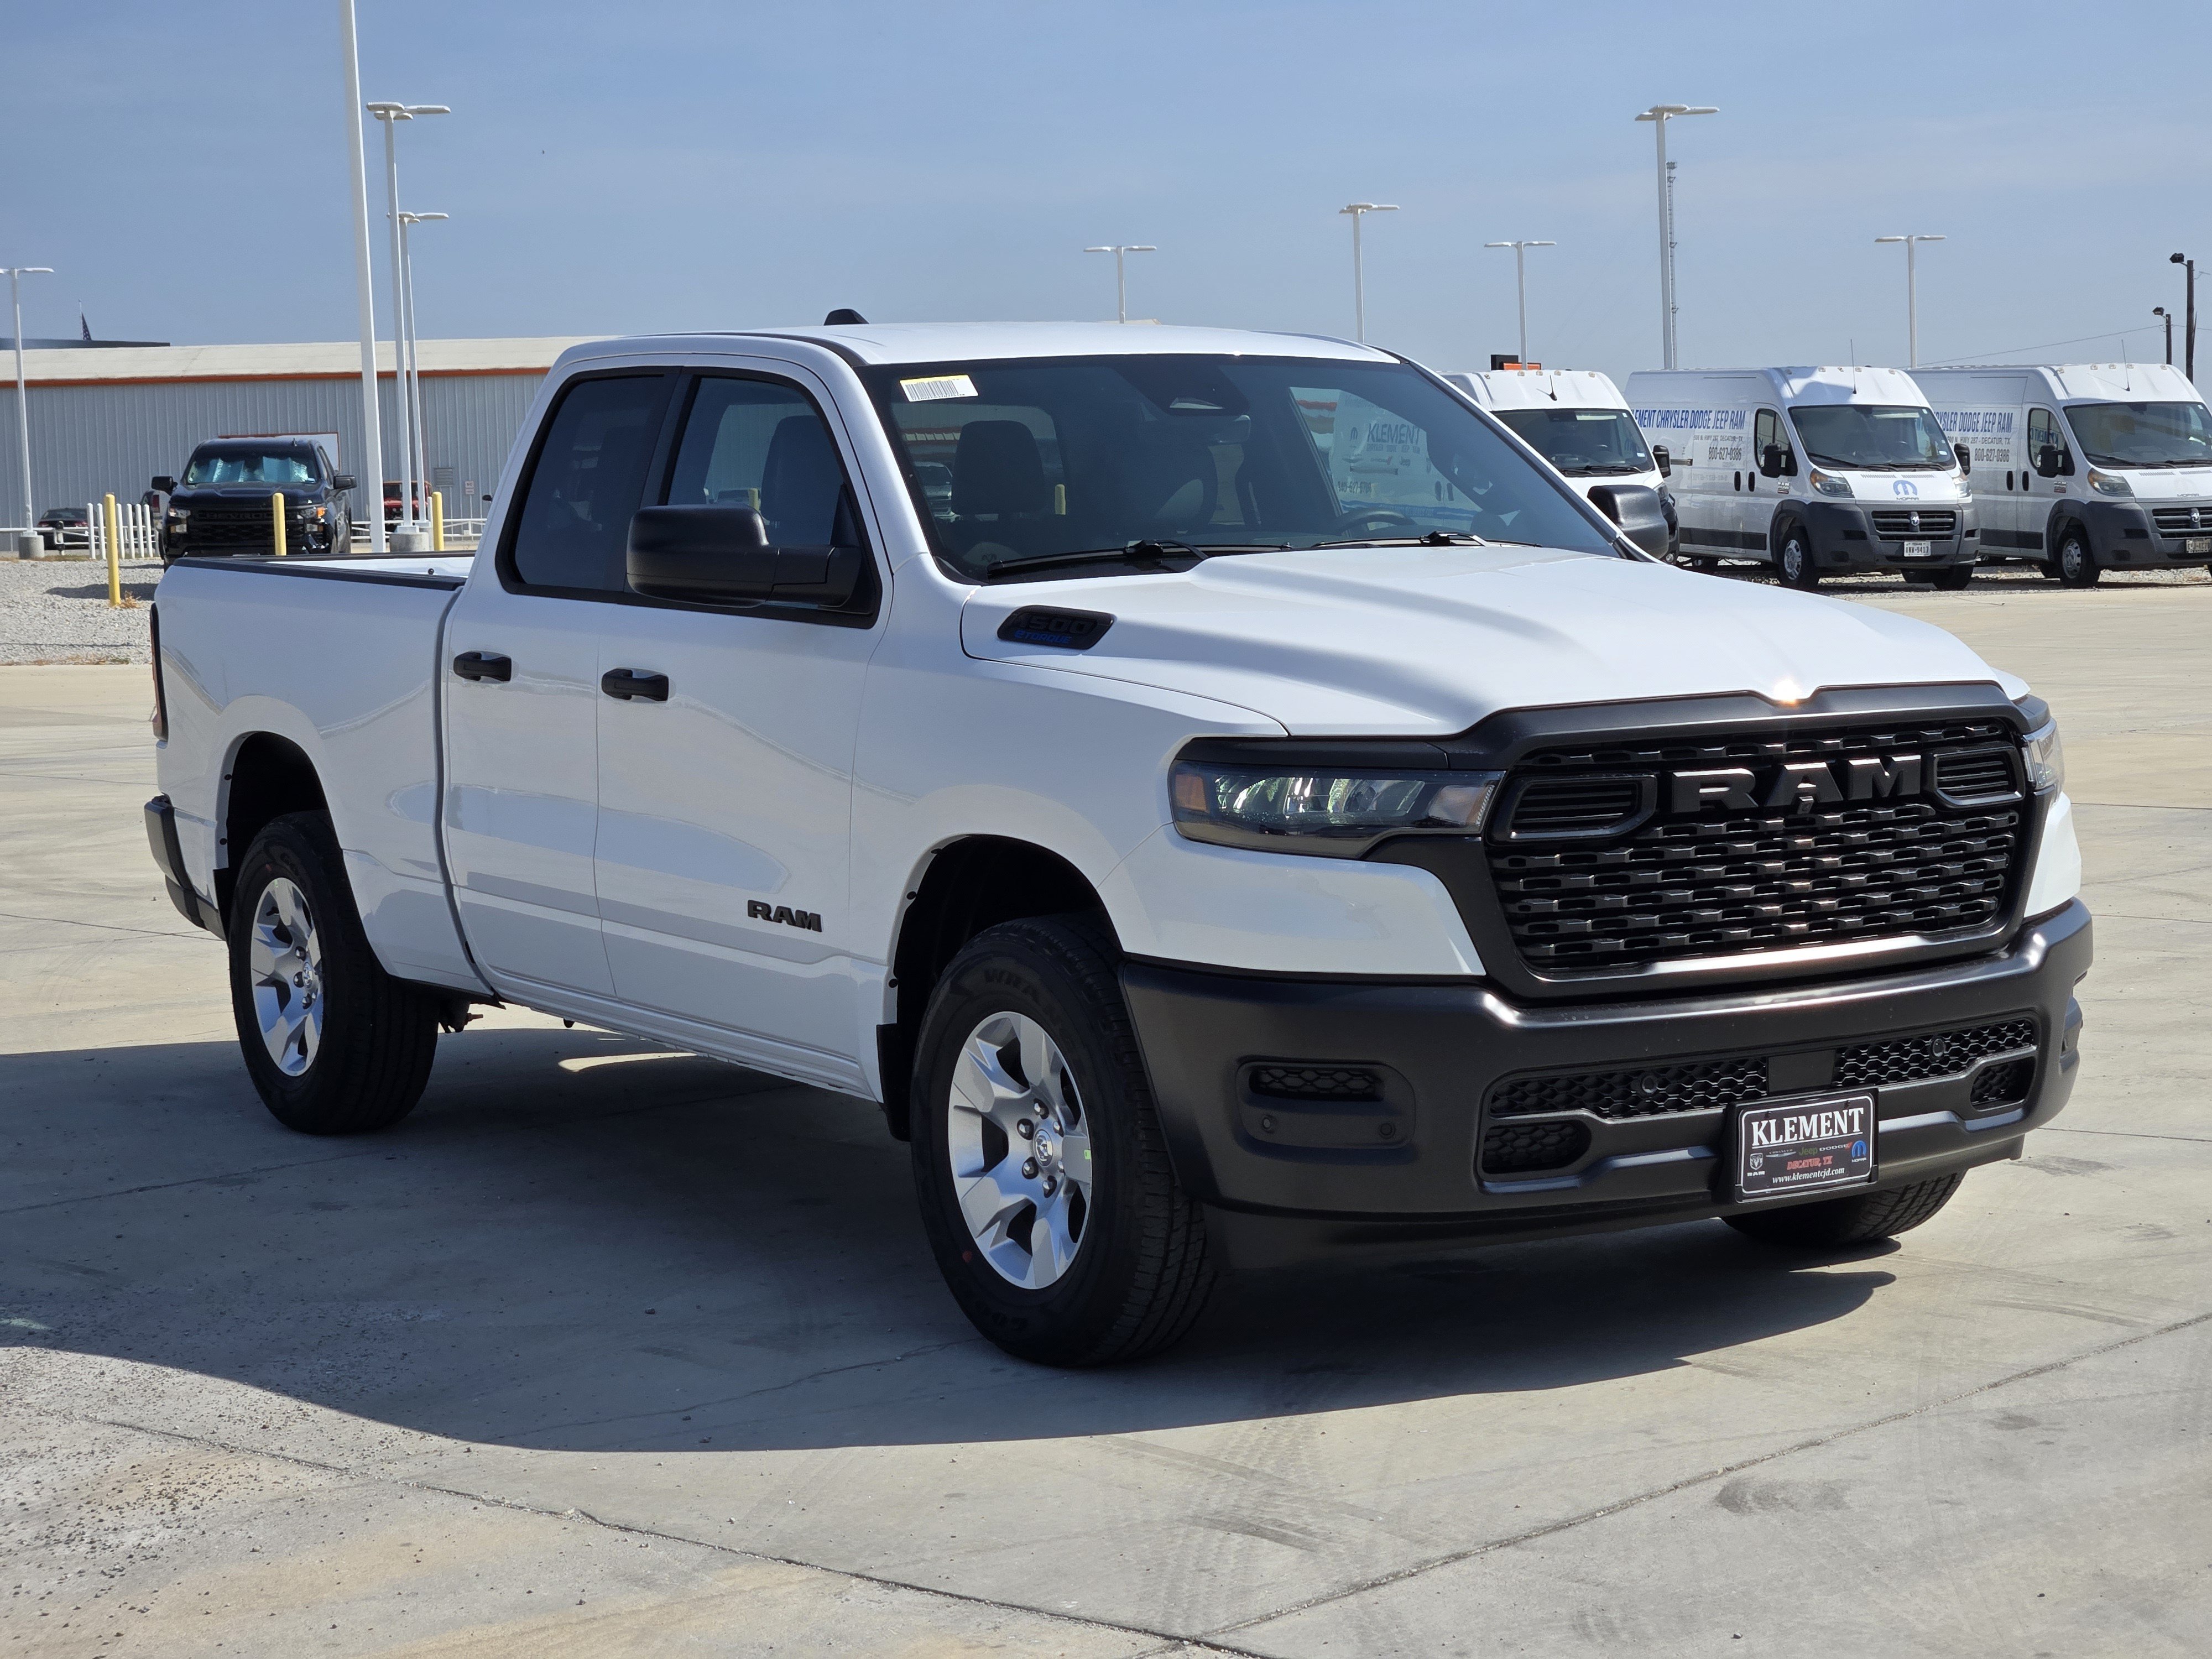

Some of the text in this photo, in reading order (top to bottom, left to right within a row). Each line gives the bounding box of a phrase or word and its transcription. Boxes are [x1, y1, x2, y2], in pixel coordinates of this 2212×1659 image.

[1631, 409, 1746, 430] EMENT CHRYSLER DODGE JEEP RAM
[1958, 412, 1981, 432] DODGE
[1980, 413, 1996, 433] JEEP
[1997, 413, 2013, 433] RAM
[1709, 446, 1742, 461] 800-627-0386
[1975, 448, 2010, 462] 800-627-0386
[1671, 754, 1922, 813] RAM
[748, 899, 822, 932] RAM
[1751, 1107, 1864, 1146] KLEMENT
[1799, 1147, 1818, 1156] Jeep
[1787, 1155, 1833, 1170] DECATUR, TX
[1772, 1167, 1845, 1184] www.klementcjd.com
